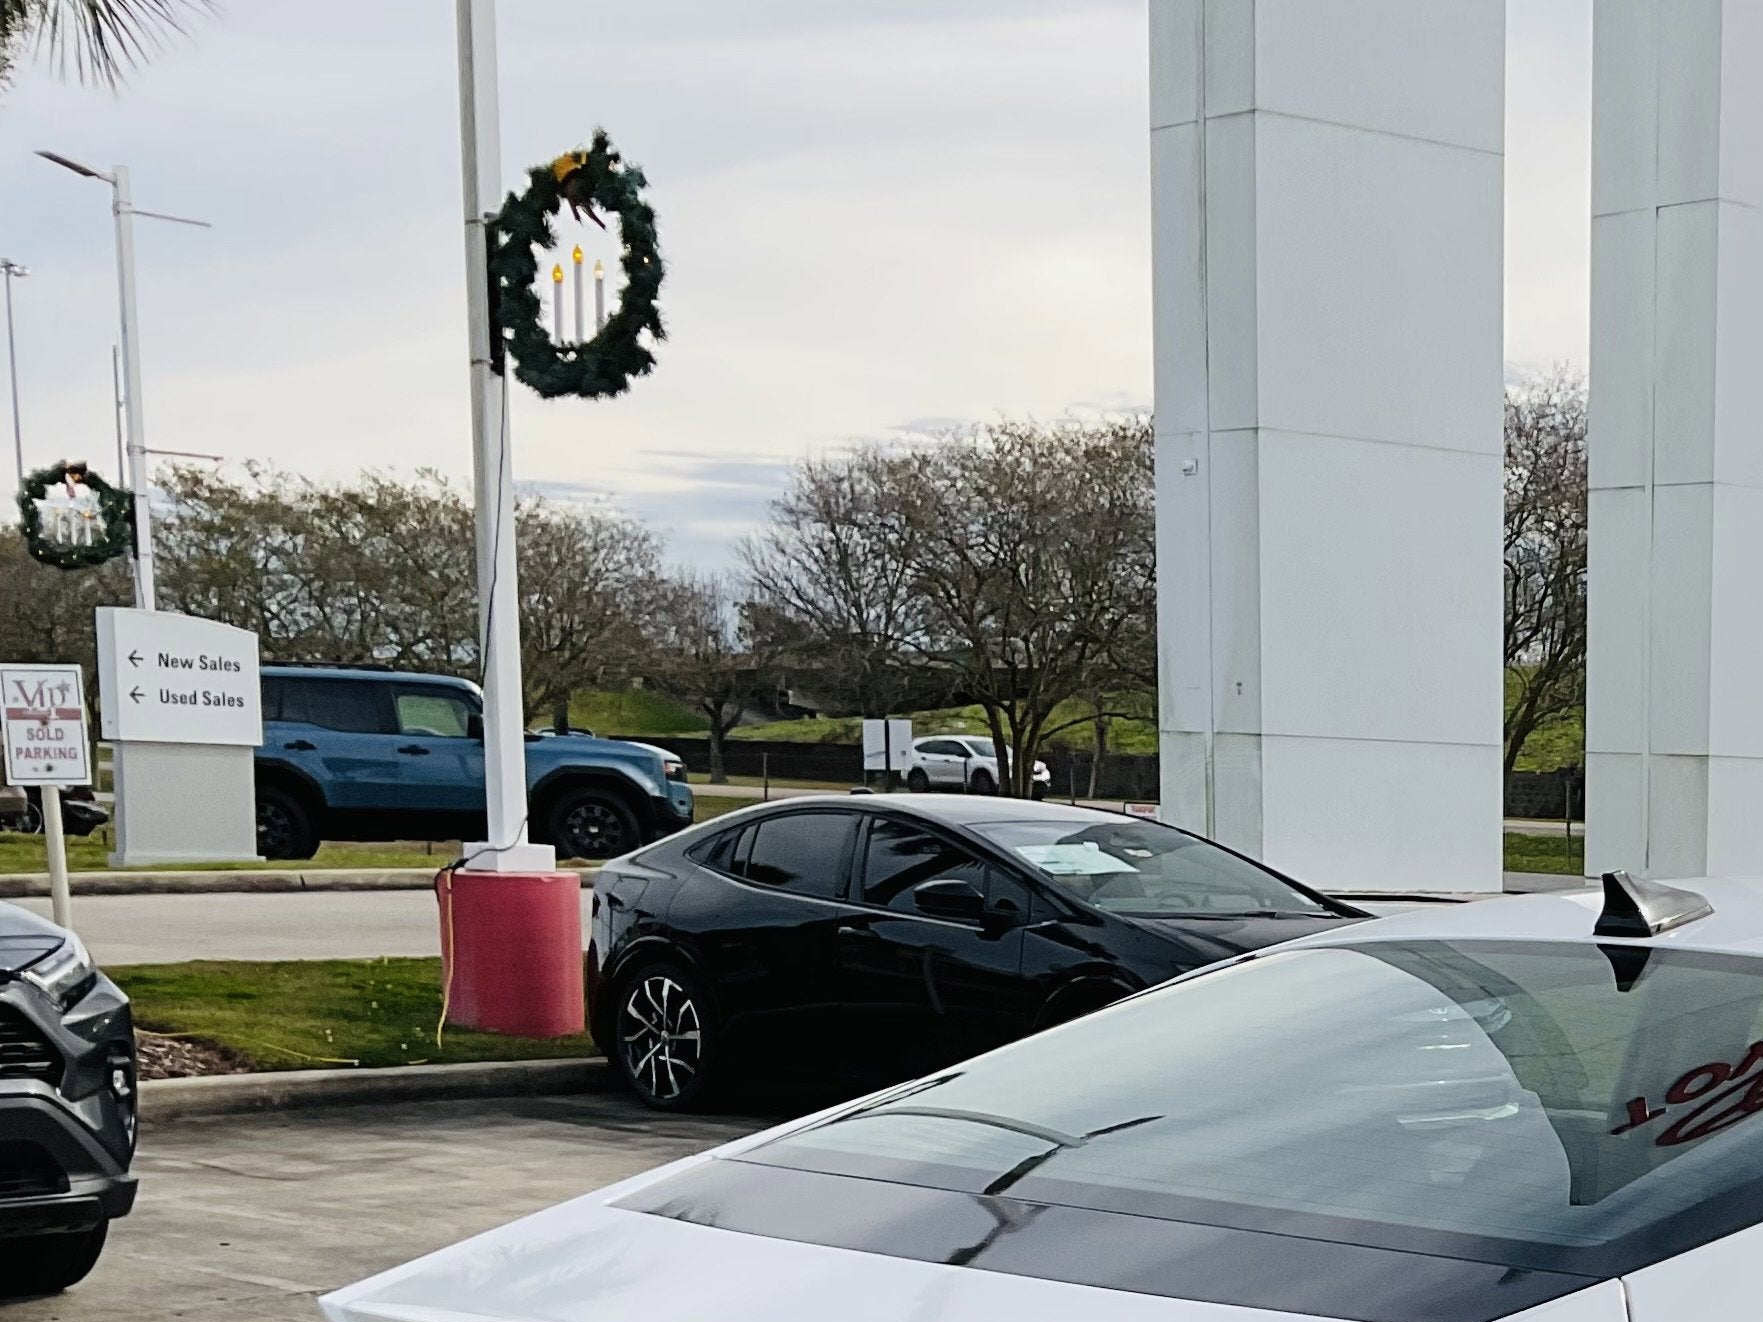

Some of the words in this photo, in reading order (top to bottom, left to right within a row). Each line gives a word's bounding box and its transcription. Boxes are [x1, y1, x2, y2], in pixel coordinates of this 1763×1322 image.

[158, 652, 193, 669] New
[199, 655, 241, 672] Sales
[159, 688, 197, 705] Used
[202, 691, 245, 708] Sales
[26, 727, 65, 741] SOLD
[15, 746, 78, 760] PARKING
